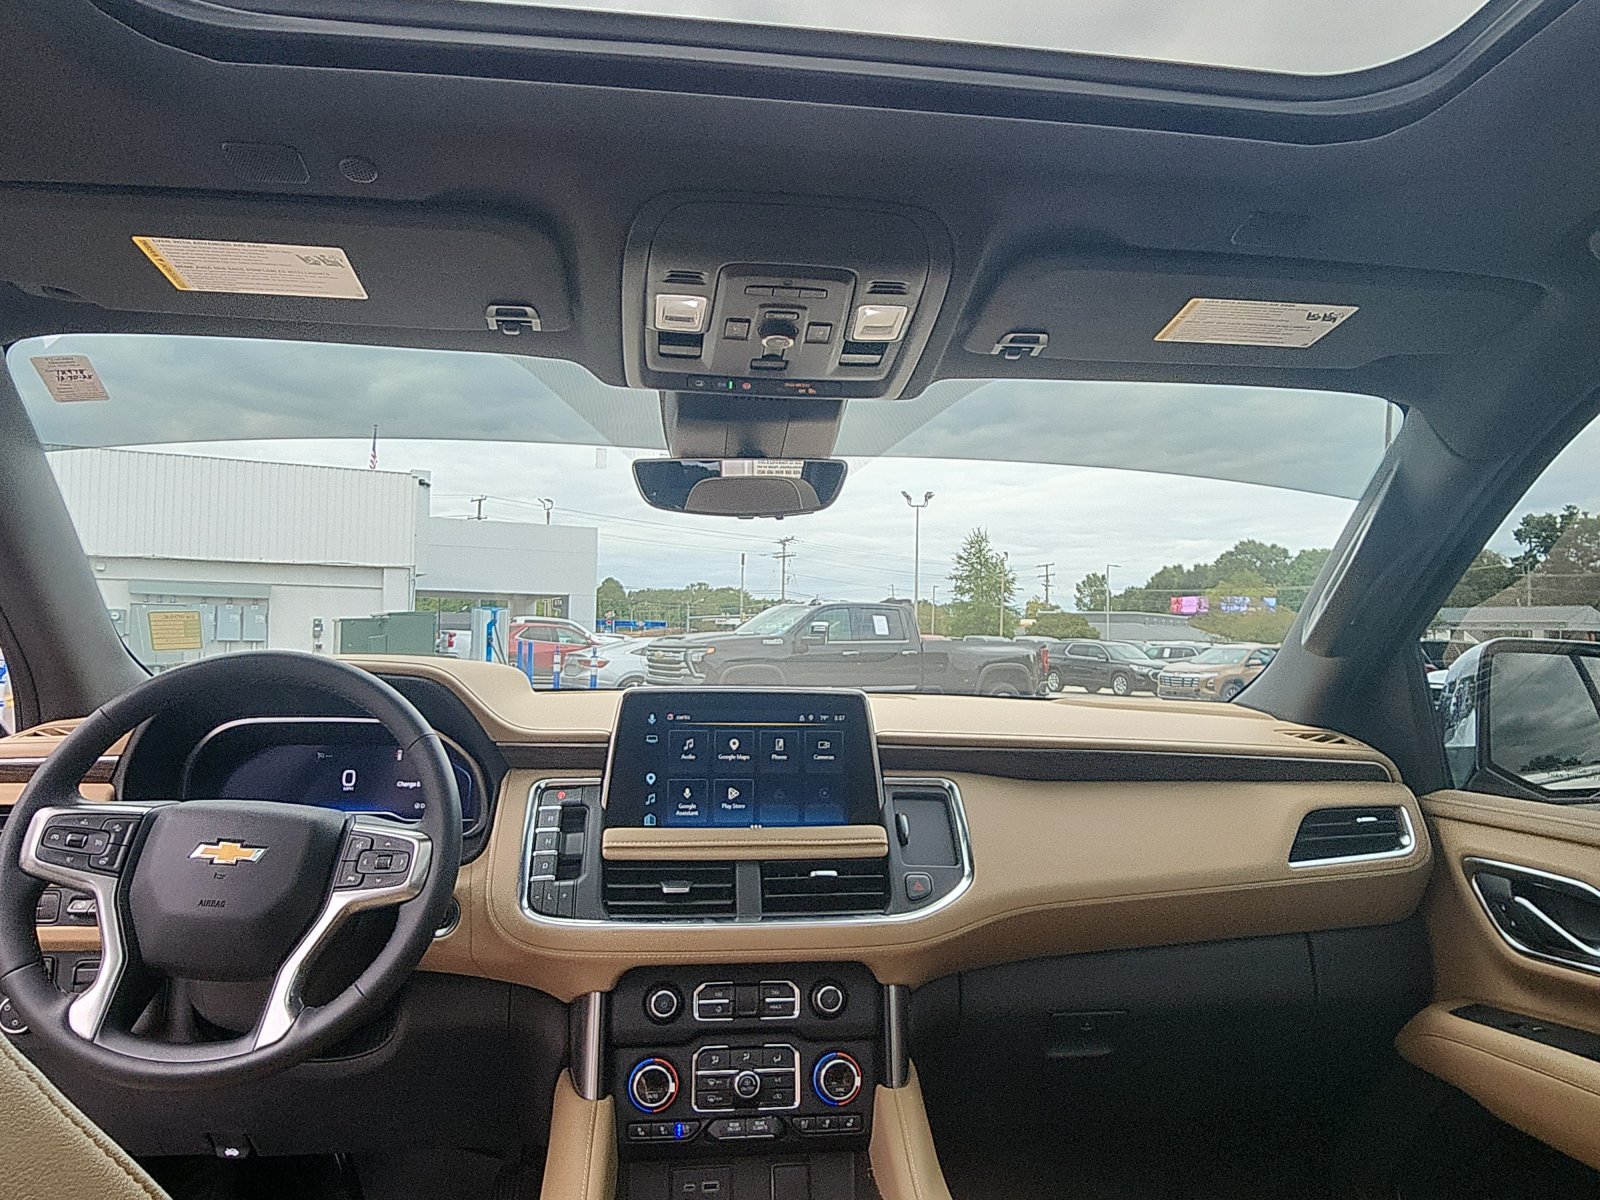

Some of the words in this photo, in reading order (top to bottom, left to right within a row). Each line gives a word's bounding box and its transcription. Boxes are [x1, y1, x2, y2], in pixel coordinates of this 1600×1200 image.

[718, 753, 736, 761] Google
[342, 769, 356, 786] 0
[197, 899, 226, 908] AIRBAG
